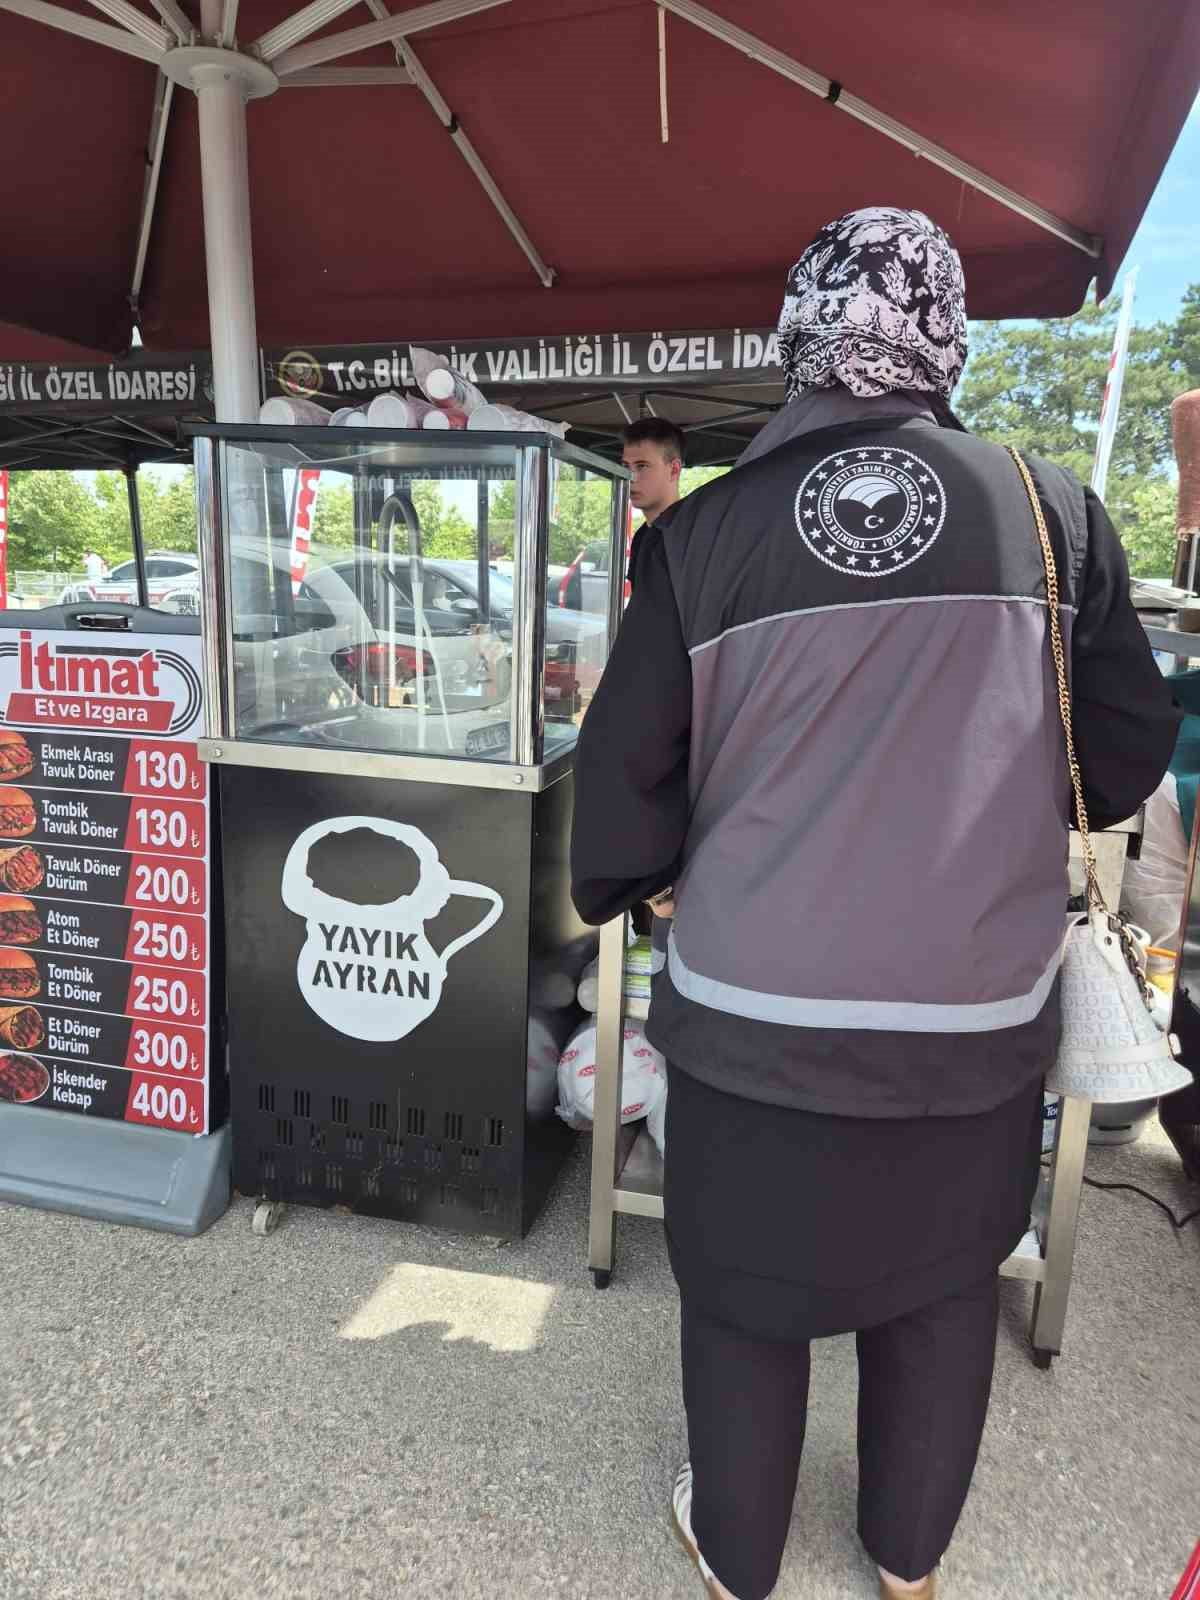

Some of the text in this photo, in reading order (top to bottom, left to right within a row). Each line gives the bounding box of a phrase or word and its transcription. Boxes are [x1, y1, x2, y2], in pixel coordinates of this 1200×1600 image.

[486, 335, 602, 382] VALİLİĞİ
[613, 333, 638, 375] İL
[648, 332, 722, 373] ÖZEL
[732, 328, 782, 368] İDA
[20, 365, 42, 400] İL
[45, 366, 103, 400] ÖZEL
[108, 363, 196, 400] İDARESİ
[852, 465, 882, 475] TARIM
[884, 467, 898, 477] VE
[35, 698, 149, 724] Et ve Izgara
[41, 744, 114, 763] Ekmek Arası
[41, 762, 115, 781] Tavuk Döner
[42, 800, 89, 818] Tombik
[42, 818, 118, 839] Tavuk Döner
[46, 855, 121, 877] Tavuk Döner
[47, 873, 88, 891] Dürüm
[47, 910, 80, 927] Atom
[47, 928, 100, 948] Et Döner
[318, 922, 419, 961] YAYIK
[48, 964, 94, 984] Tombik
[312, 959, 430, 1000] AYRAN
[48, 982, 102, 1003] Et Döner
[48, 1017, 102, 1038] Et Döner
[48, 1036, 89, 1055] Dürüm
[52, 1065, 107, 1091] İskender
[52, 1087, 92, 1109] Kebap
